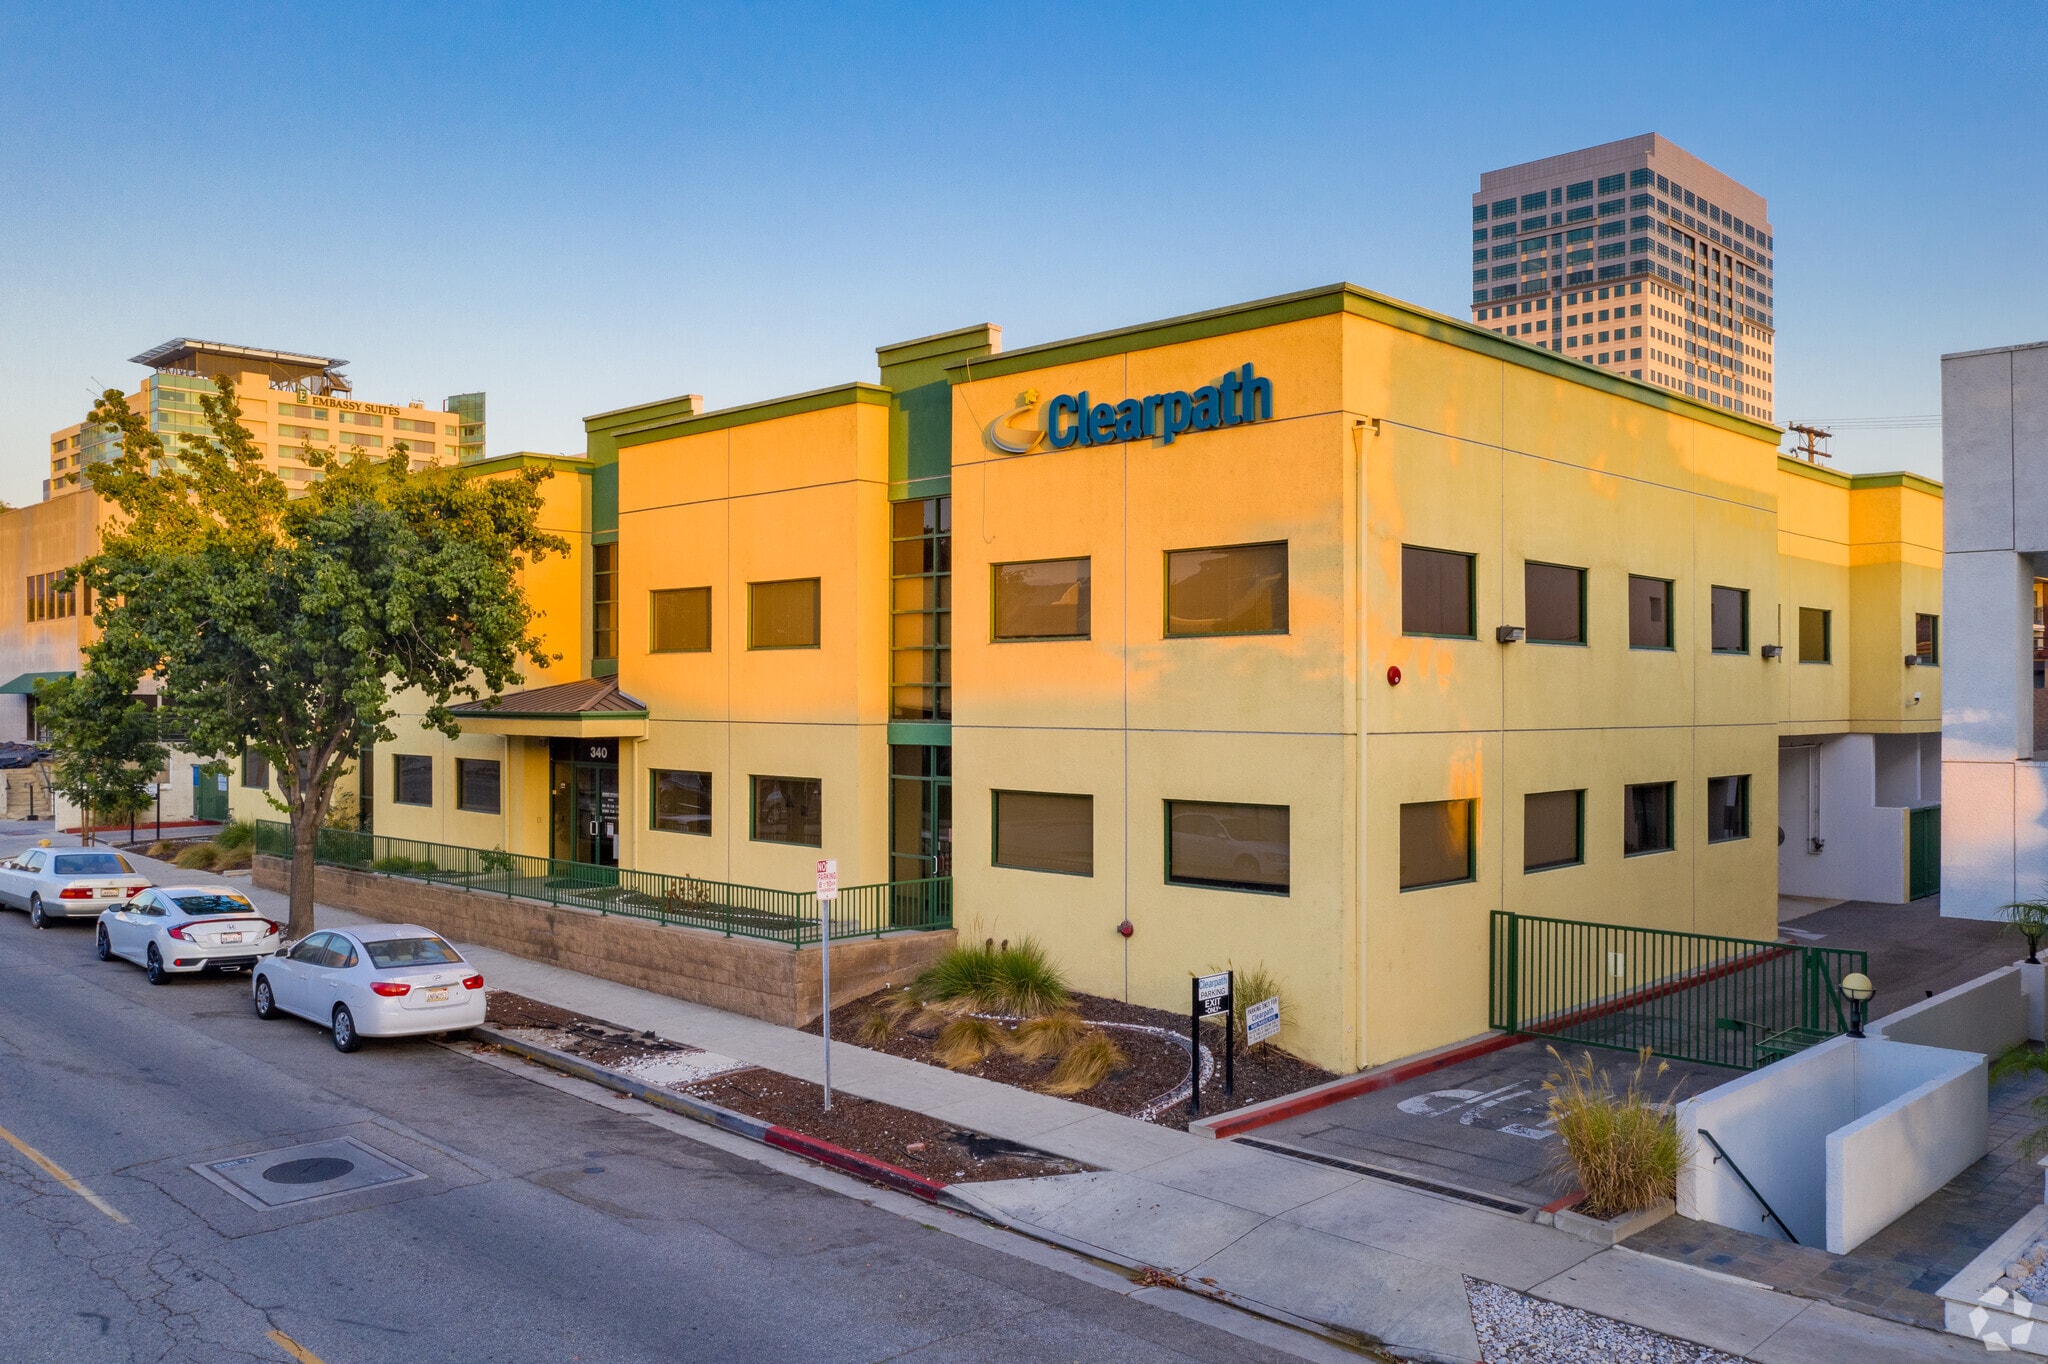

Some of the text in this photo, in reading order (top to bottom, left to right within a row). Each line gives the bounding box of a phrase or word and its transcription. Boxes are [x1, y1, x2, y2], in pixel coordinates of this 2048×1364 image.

[312, 396, 400, 416] EMBASSY SUITES
[1048, 362, 1273, 447] Clearpath
[590, 746, 608, 758] 340
[818, 862, 826, 872] NO
[818, 872, 837, 881] PARKING
[1199, 976, 1228, 990] Clearpath
[1200, 987, 1226, 1000] PARKING
[1204, 997, 1222, 1008] EXIT
[1247, 1004, 1262, 1015] PARKING
[1270, 998, 1278, 1006] FOR
[1251, 1007, 1275, 1022] Clearpath
